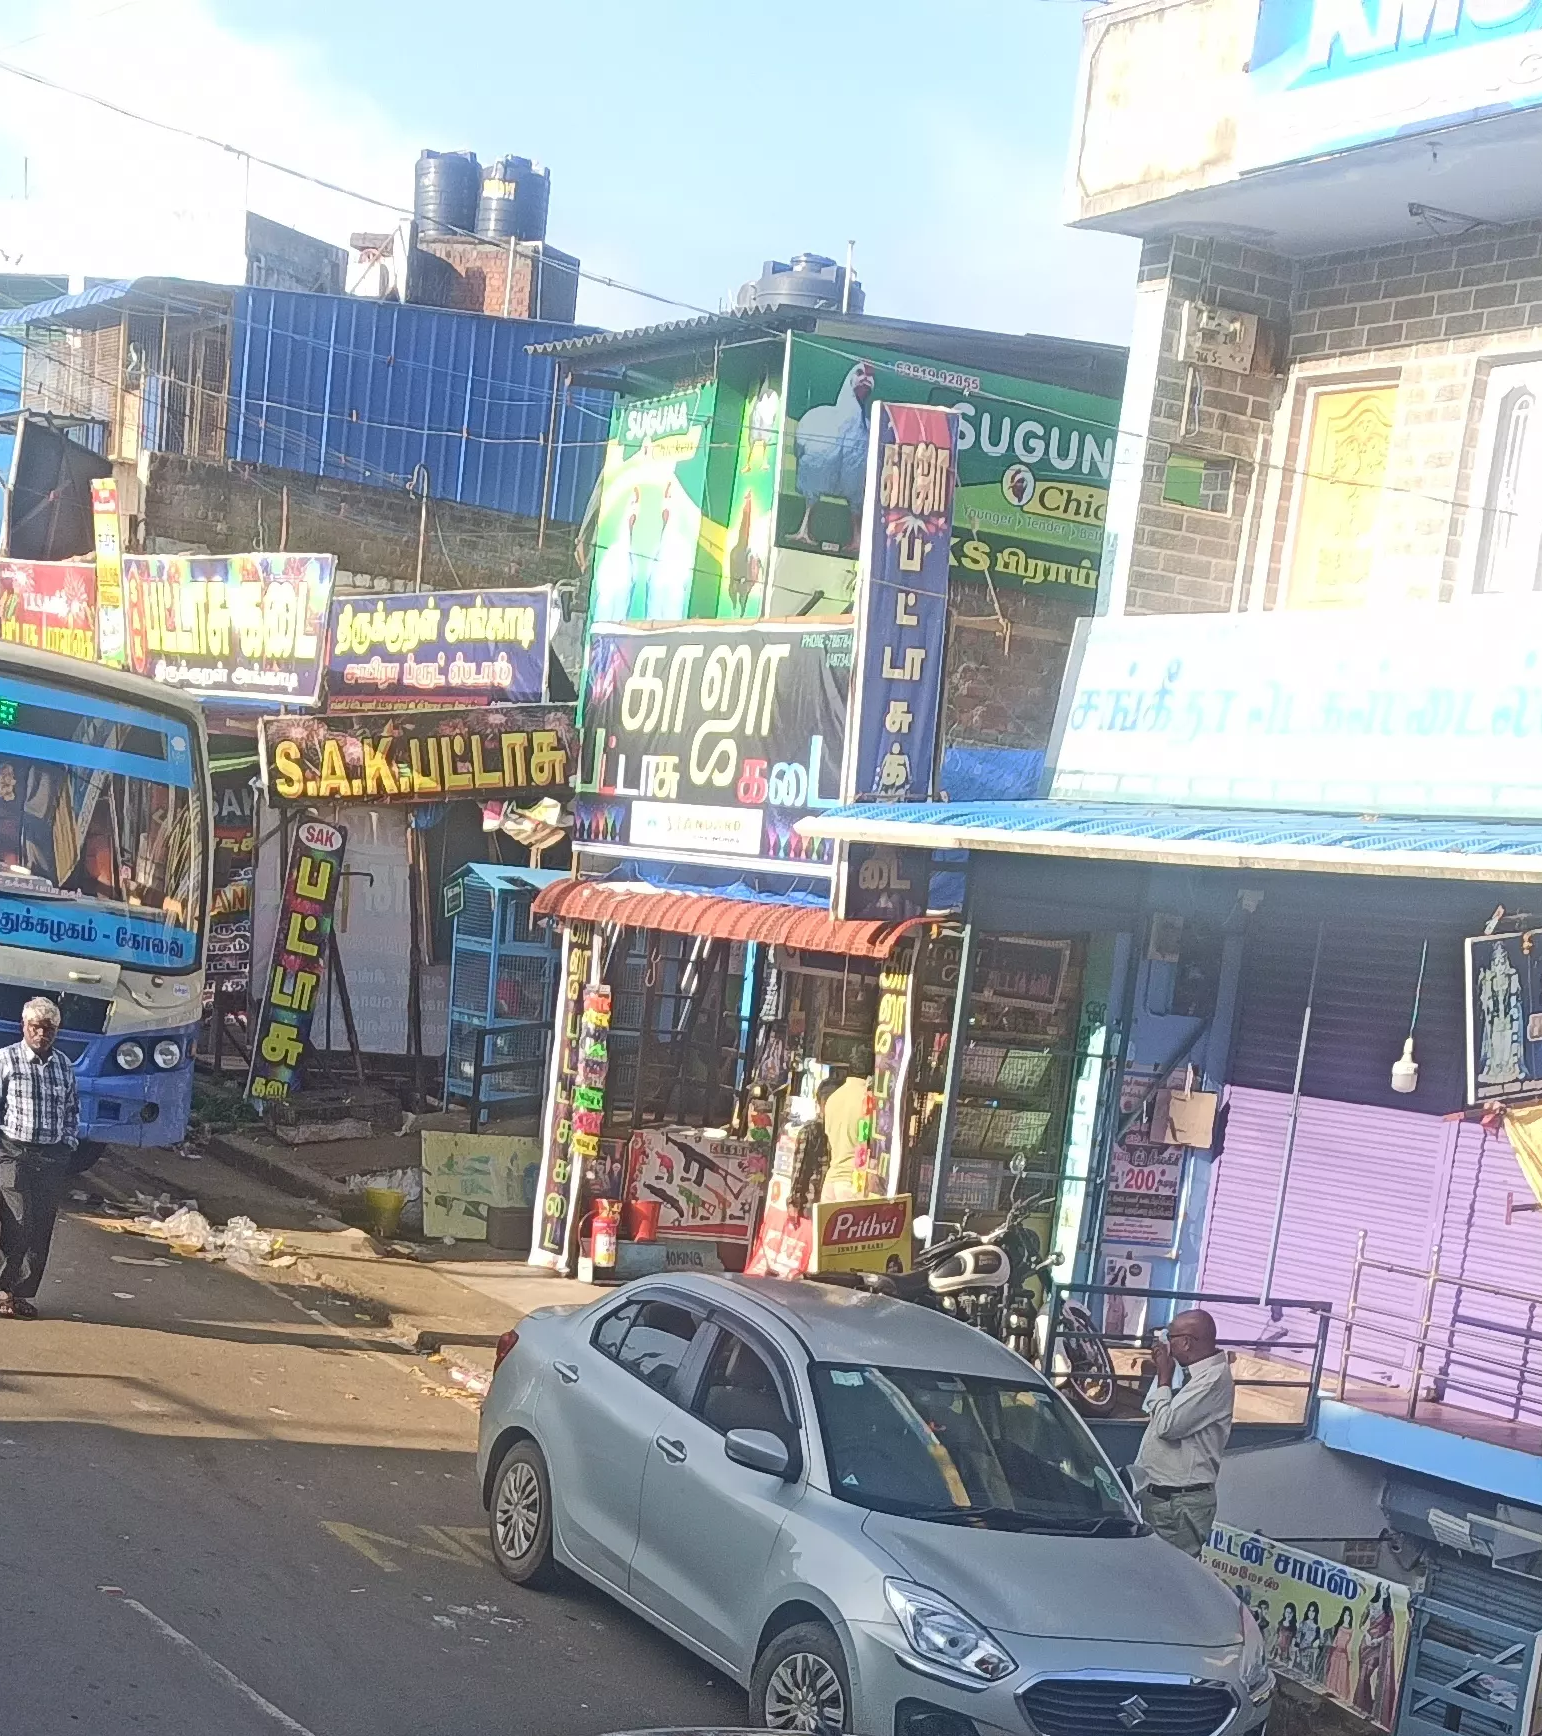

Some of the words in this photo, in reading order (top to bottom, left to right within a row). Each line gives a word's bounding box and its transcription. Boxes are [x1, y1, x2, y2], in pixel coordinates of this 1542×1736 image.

[626, 401, 688, 441] SUGUNA
[953, 402, 1114, 479] SUGUN
[1039, 486, 1106, 522] Chic
[335, 596, 441, 655] திருக்குறள்
[445, 594, 535, 650] அங்காடி
[737, 735, 846, 808] கடை
[305, 826, 335, 849] SAK
